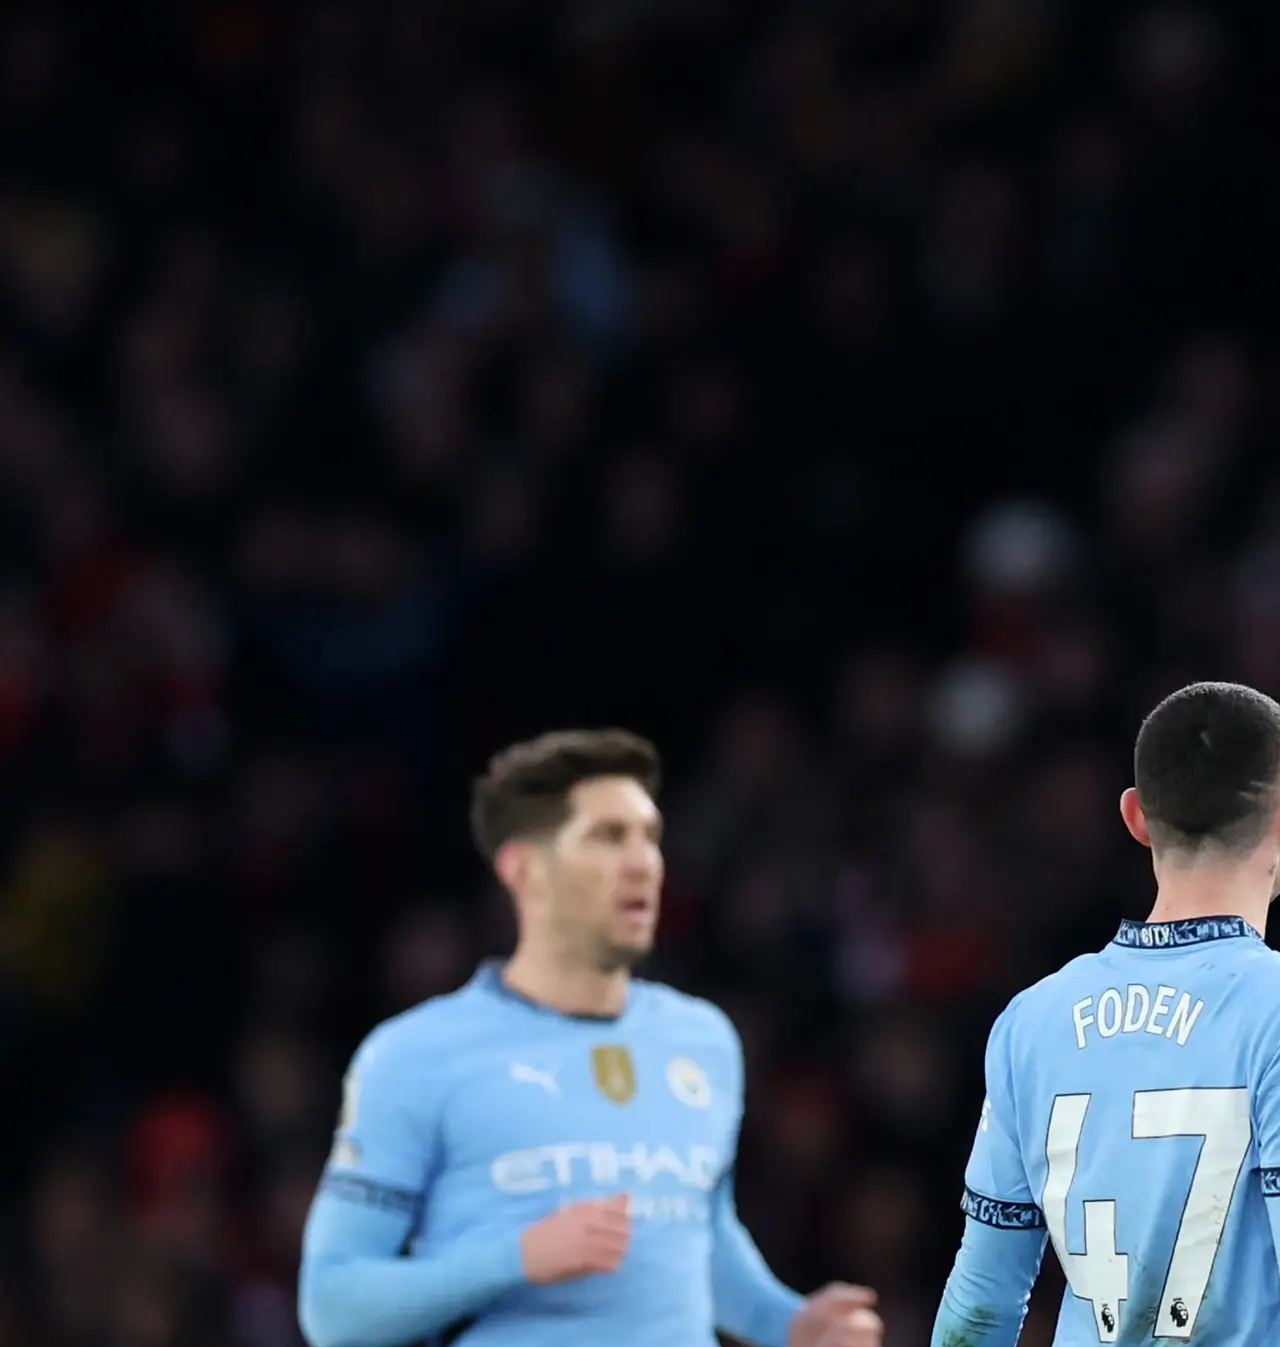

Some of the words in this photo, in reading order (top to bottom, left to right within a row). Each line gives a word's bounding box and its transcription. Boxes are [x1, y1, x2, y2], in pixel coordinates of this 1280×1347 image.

[1139, 925, 1171, 947] CITY
[1072, 983, 1204, 1050] FODEN
[1041, 1086, 1253, 1343] 47
